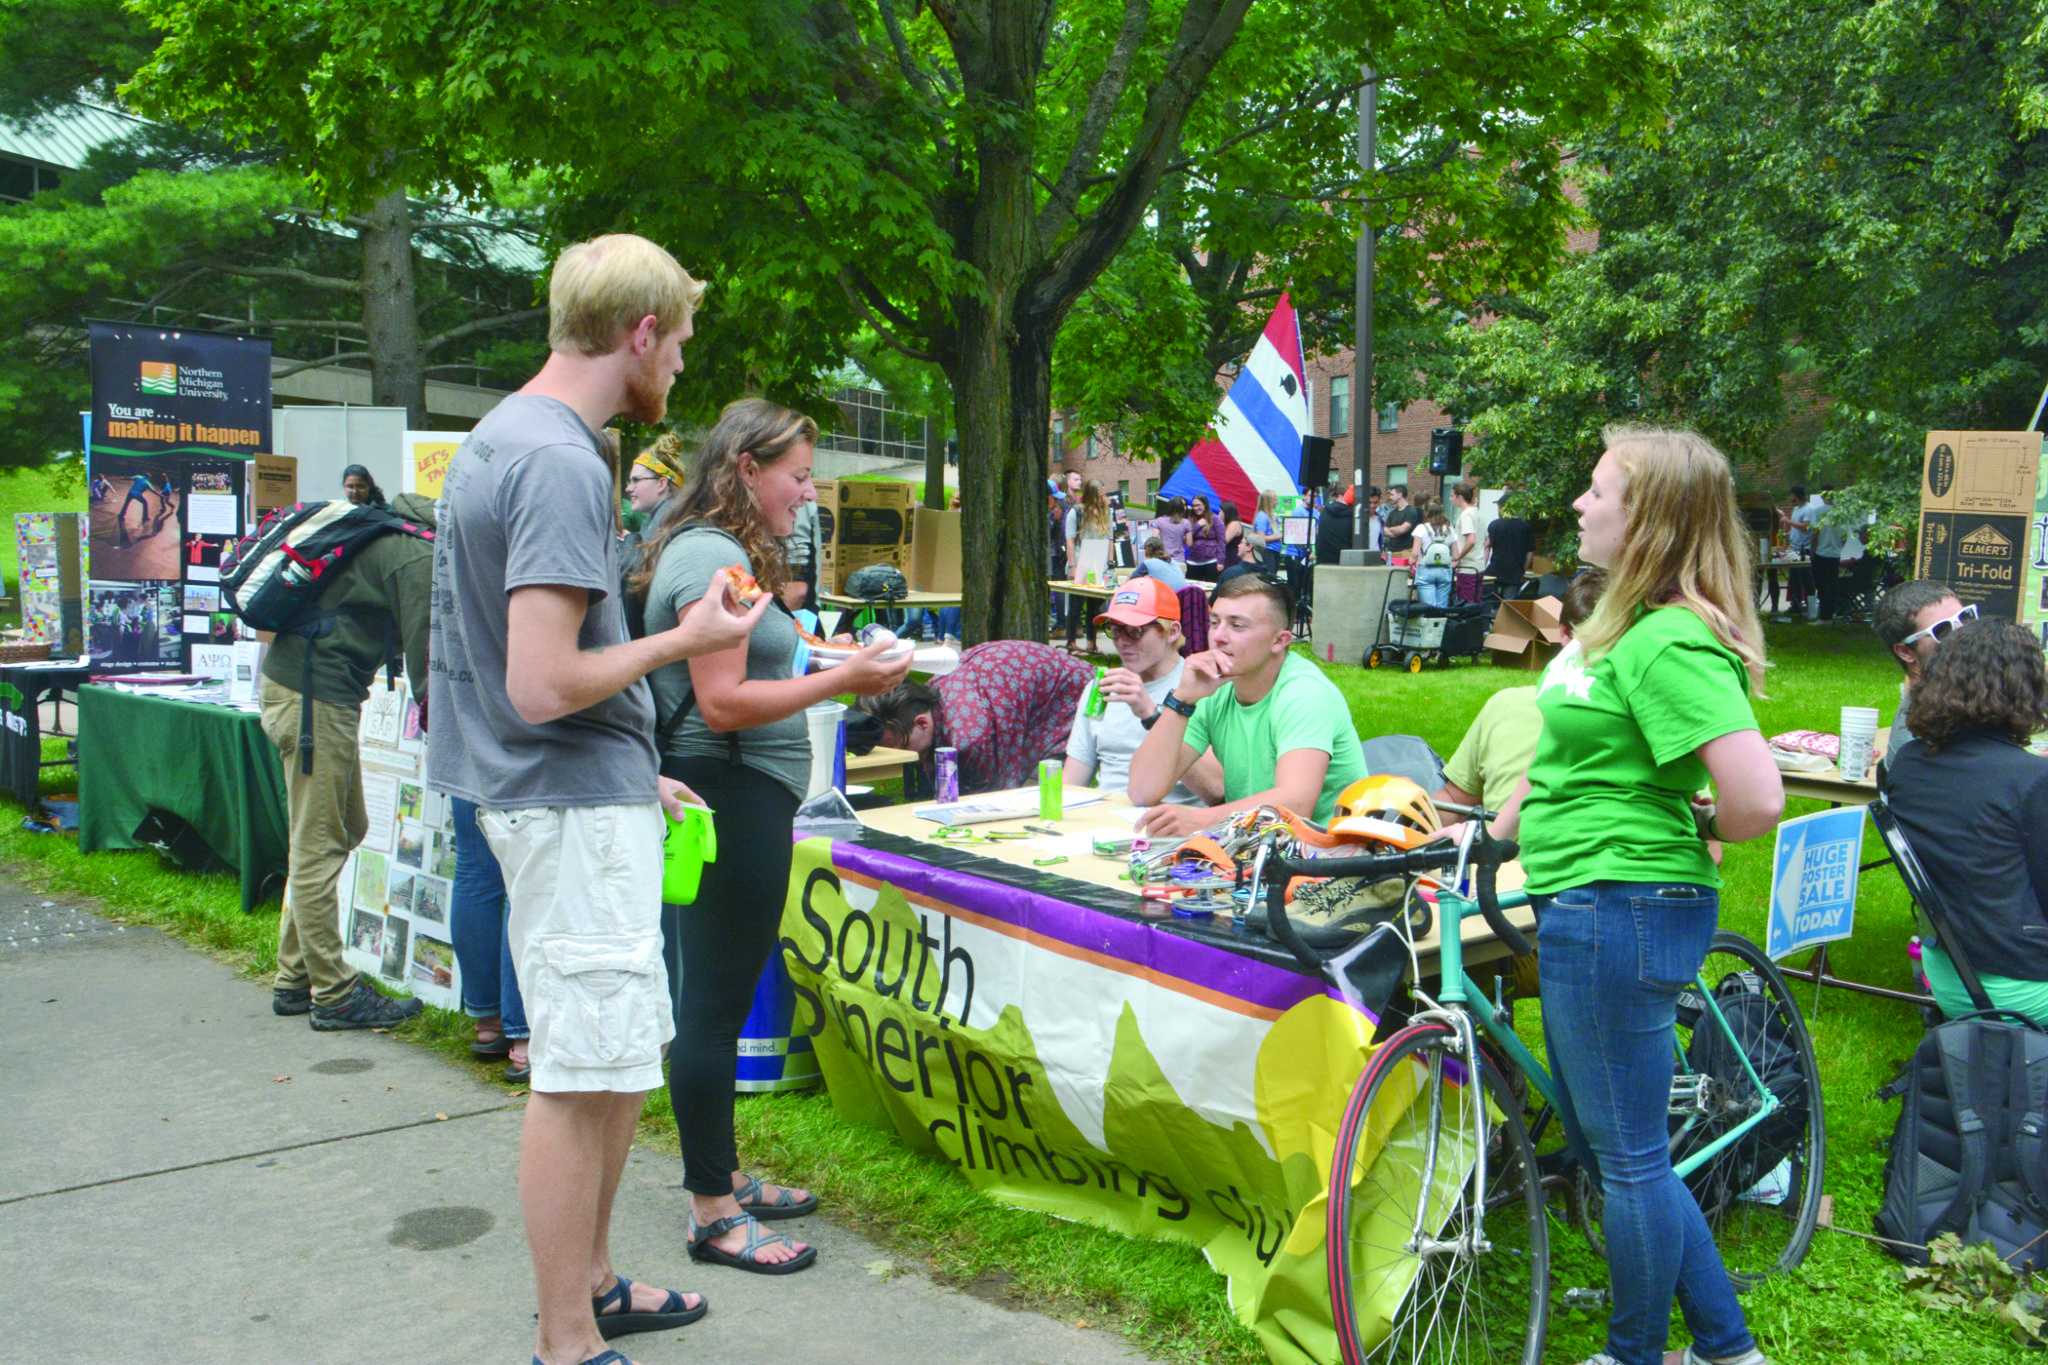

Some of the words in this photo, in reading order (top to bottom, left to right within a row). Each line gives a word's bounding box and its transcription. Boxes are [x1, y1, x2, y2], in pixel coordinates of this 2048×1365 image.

[179, 366, 223, 378] Northern
[179, 377, 224, 390] Michigan
[178, 388, 229, 401] University
[108, 403, 132, 417] You
[135, 407, 154, 418] are
[108, 420, 177, 443] making
[179, 423, 193, 442] it
[195, 423, 260, 446] happen
[417, 449, 450, 473] LET'S
[1925, 522, 1935, 555] Tri-Fold
[1962, 544, 2009, 556] ELMER'S
[1957, 562, 2013, 580] Tri-Fold
[1804, 843, 1849, 871] HUGE
[1801, 864, 1846, 886] POSTER
[1799, 880, 1845, 908] SALE
[1795, 908, 1844, 935] TODAY
[781, 867, 975, 1028] South
[750, 1042, 778, 1053] mind.
[928, 1104, 1190, 1222] climbing
[1206, 1185, 1294, 1268] clu
